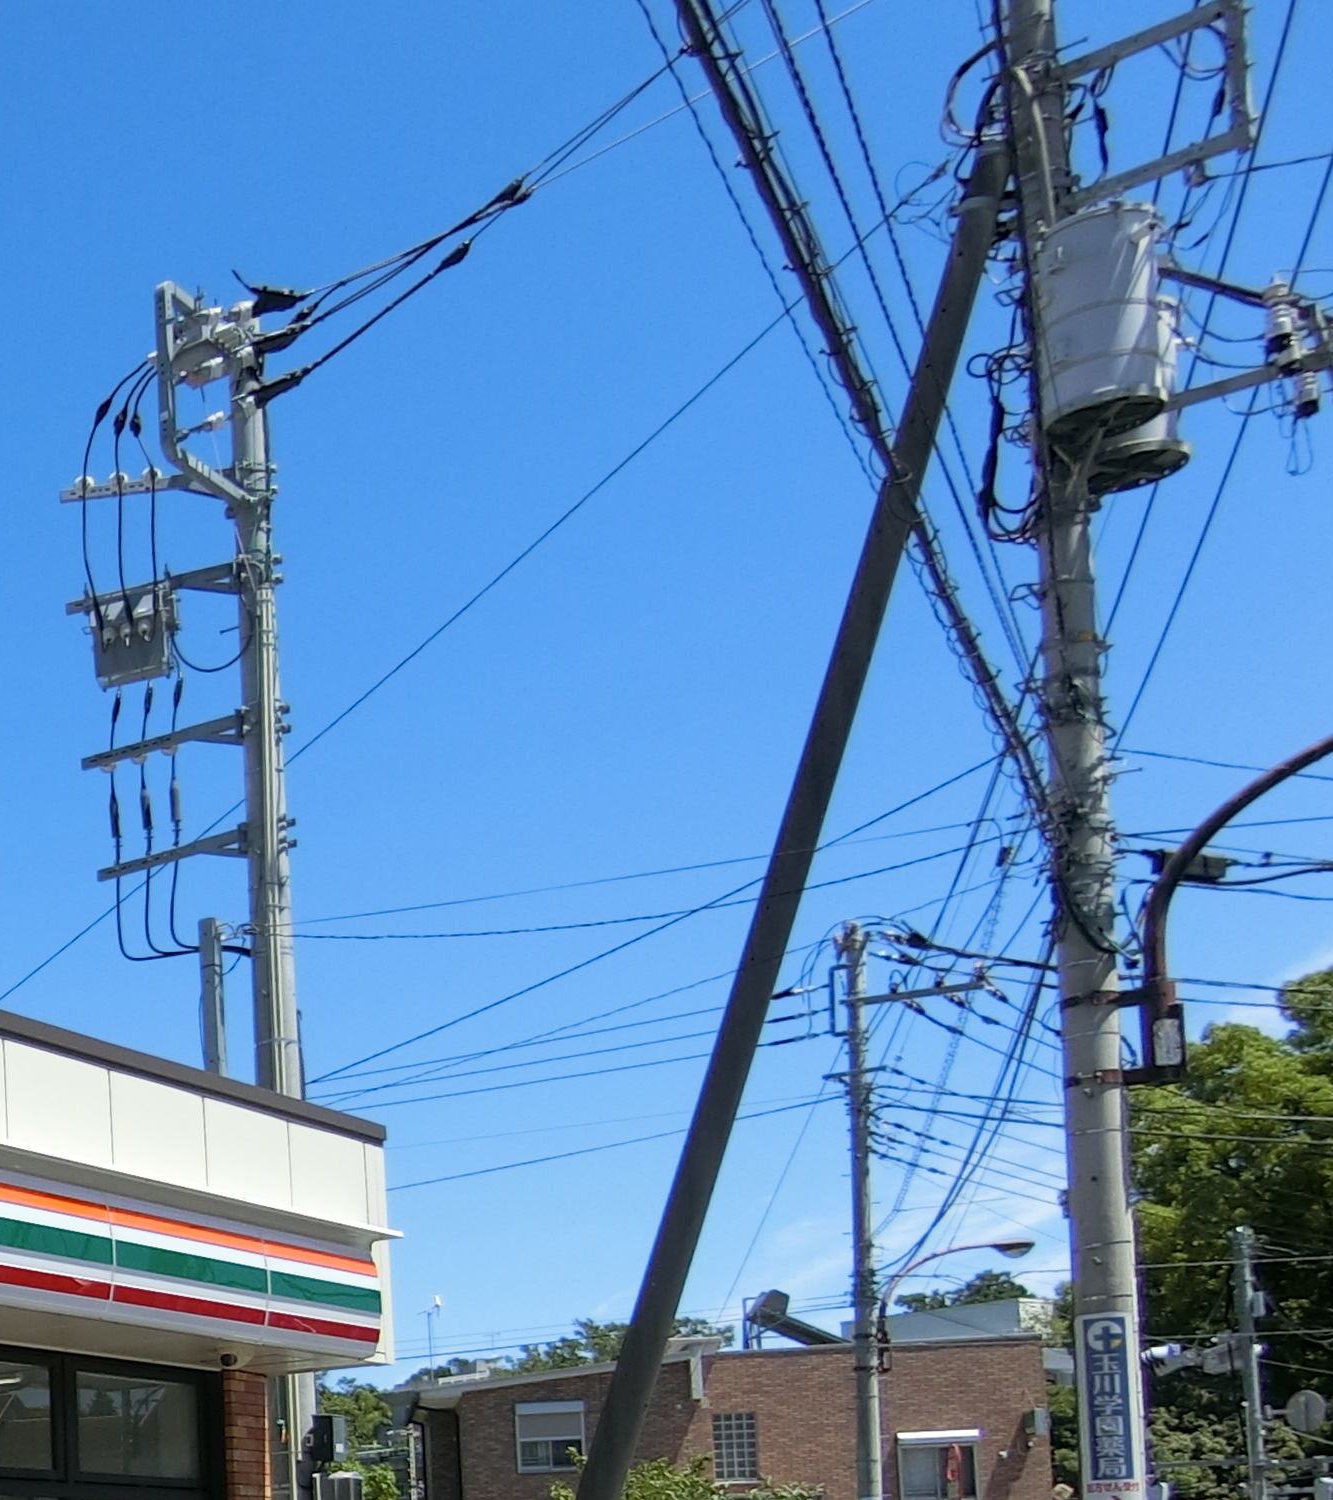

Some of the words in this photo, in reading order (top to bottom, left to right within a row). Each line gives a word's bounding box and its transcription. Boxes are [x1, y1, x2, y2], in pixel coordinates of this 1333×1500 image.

[1092, 1353, 1127, 1478] 玉川学園薬局
